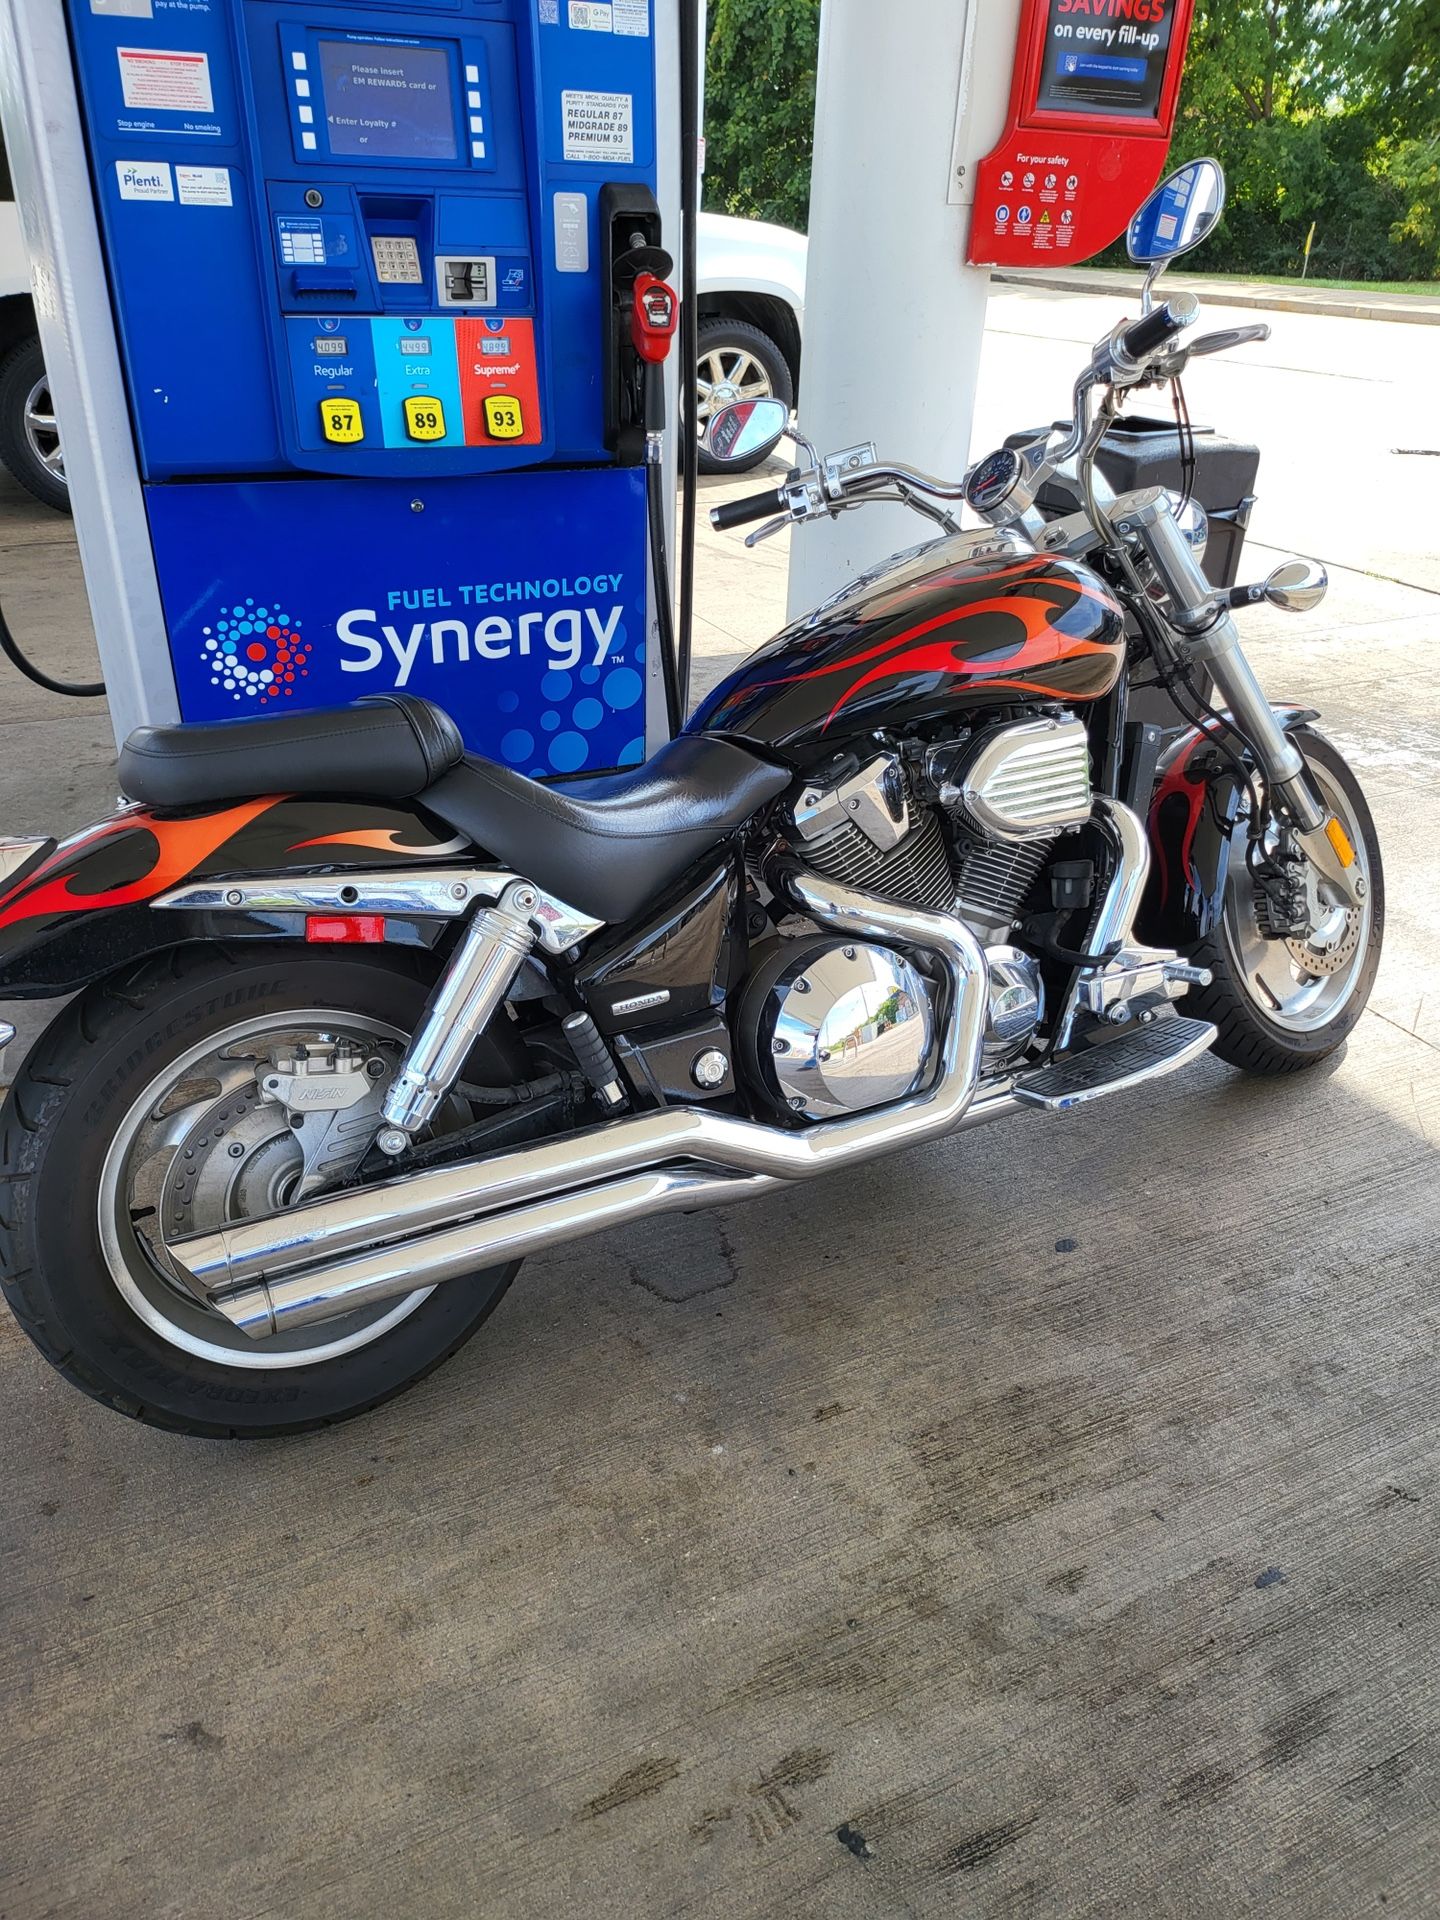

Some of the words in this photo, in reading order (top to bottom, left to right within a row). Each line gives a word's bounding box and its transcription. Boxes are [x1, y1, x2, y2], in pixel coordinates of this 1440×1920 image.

[155, 1, 167, 9] pay
[1054, 24, 1073, 38] on
[1076, 26, 1116, 47] every
[1118, 25, 1160, 51] fill-up
[352, 64, 379, 75] Please
[380, 67, 404, 77] insert
[353, 77, 365, 86] EM
[367, 78, 407, 88] REWARDS
[408, 82, 427, 90] card
[567, 109, 610, 120] REGULAR
[612, 112, 623, 120] 87
[117, 119, 133, 128] Stop
[133, 121, 155, 129] engine
[195, 124, 221, 133] smoking
[336, 117, 358, 126] Enter
[360, 119, 389, 129] Loyalty
[567, 120, 616, 131] MIDGRADE
[617, 124, 628, 132] 89
[568, 132, 611, 143] PREMIUM
[613, 134, 623, 143] 93
[1017, 153, 1030, 162] For
[1030, 156, 1047, 165] your
[1047, 155, 1069, 168] safety
[314, 364, 354, 379] Regular
[405, 364, 430, 375] Extra
[331, 415, 353, 430] 87
[415, 413, 437, 428] 89
[493, 411, 515, 427] 93
[387, 589, 451, 610] FUEL
[458, 573, 624, 605] TECHNOLOGY
[335, 605, 624, 687] Synergy
[618, 995, 665, 1011] HONDA
